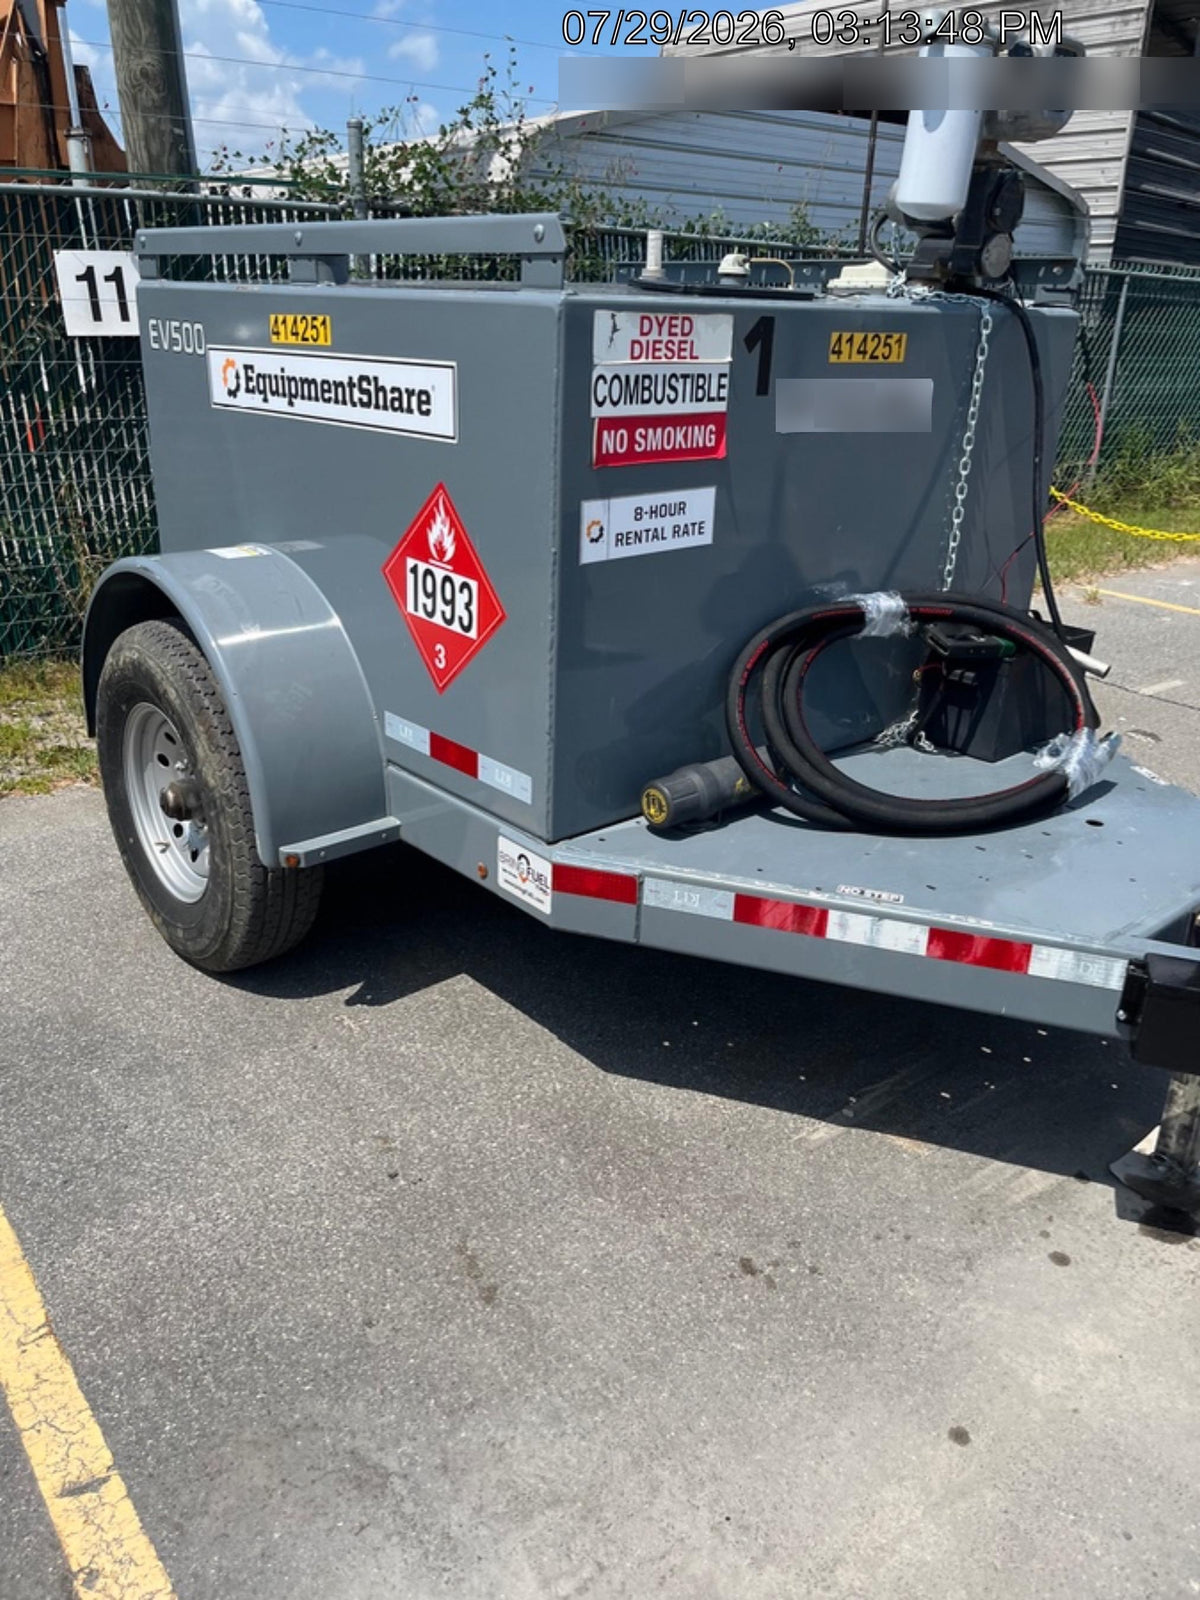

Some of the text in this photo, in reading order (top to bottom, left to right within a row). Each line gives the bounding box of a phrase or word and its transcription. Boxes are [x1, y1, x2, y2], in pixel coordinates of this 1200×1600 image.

[75, 265, 131, 323] 11
[148, 318, 206, 355] EV500
[271, 315, 329, 343] 414251
[639, 315, 694, 337] DYED
[630, 339, 699, 361] DIESEL
[742, 315, 776, 397] 1
[830, 333, 903, 361] 414251
[242, 364, 433, 417] EquipmentShare
[593, 373, 728, 408] COMBUSTIBLE
[602, 424, 717, 454] NO SMOKING
[633, 501, 687, 522] 8-HOUR
[614, 520, 706, 548] RENTAL RATE
[408, 563, 474, 634] 1993
[434, 642, 447, 669] 3
